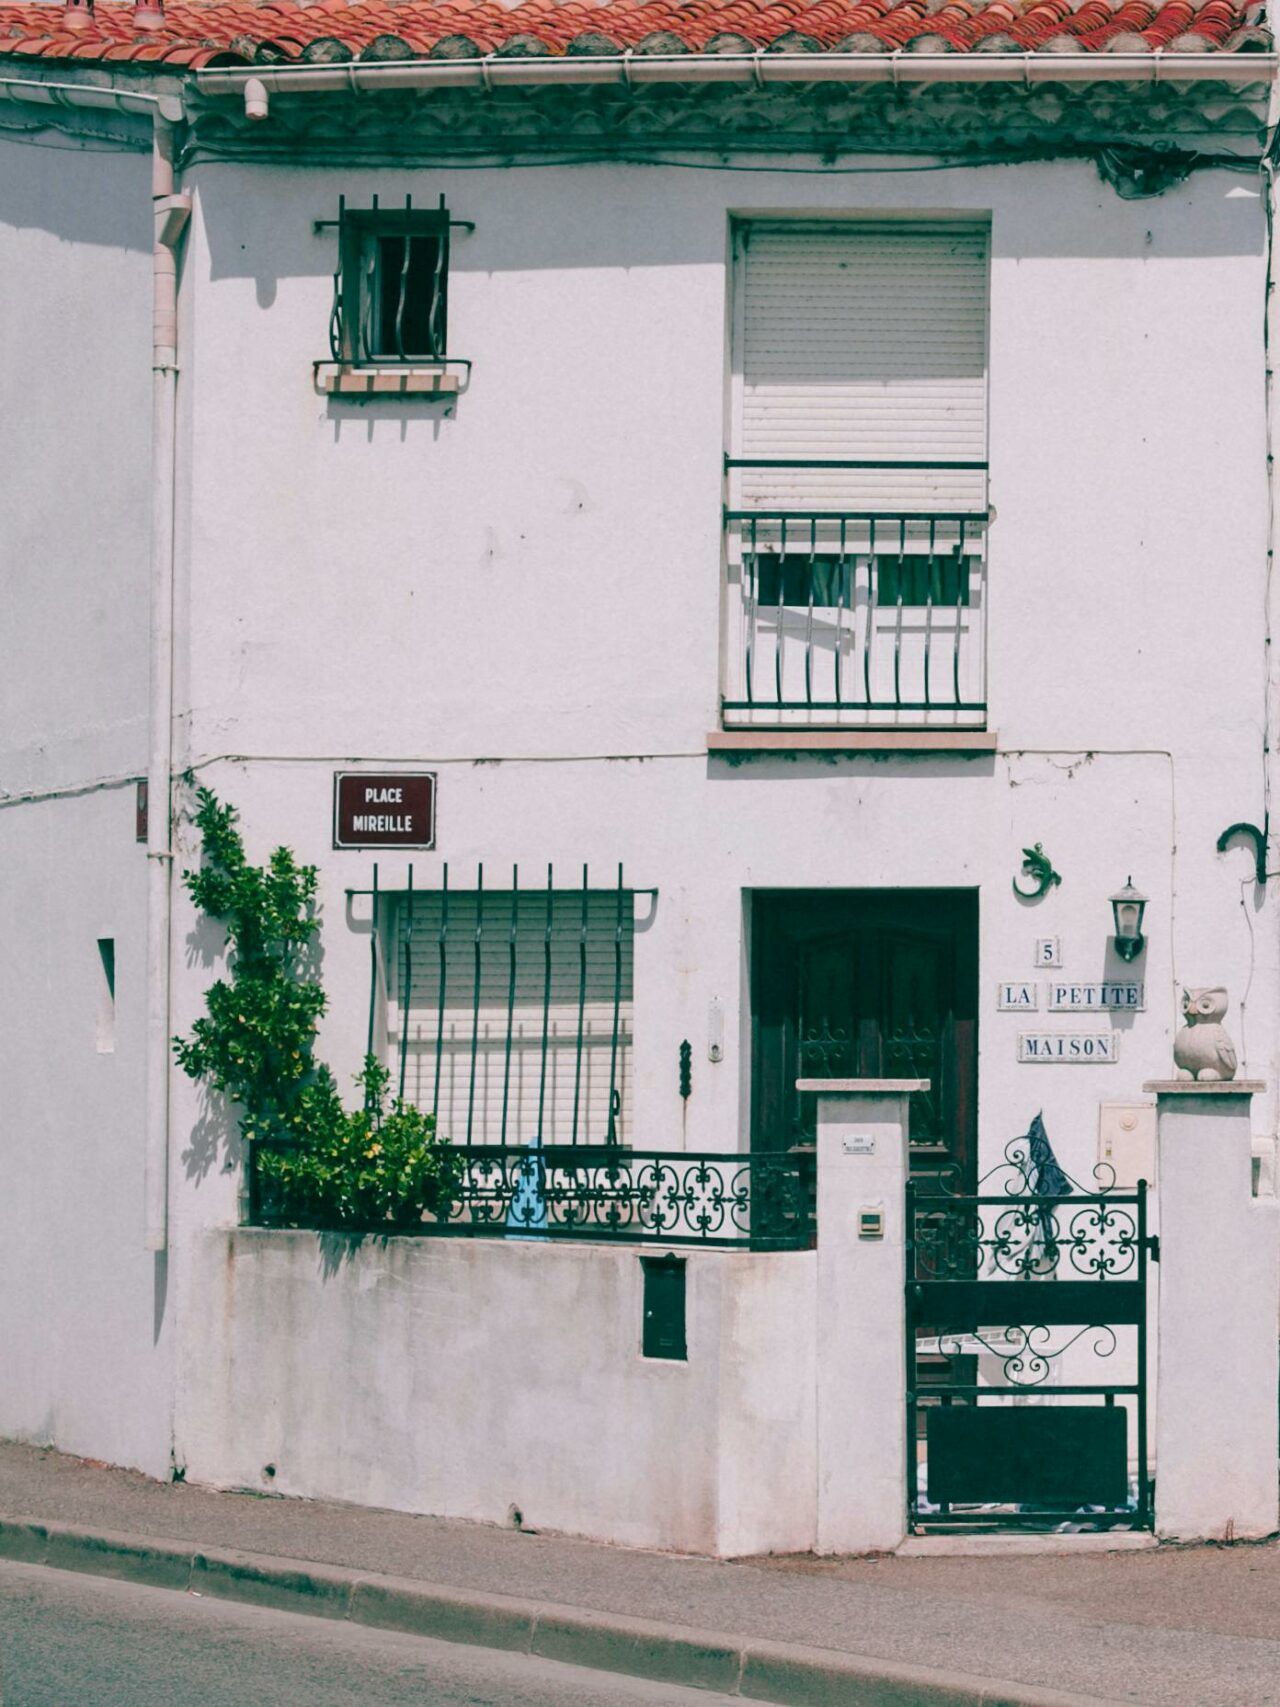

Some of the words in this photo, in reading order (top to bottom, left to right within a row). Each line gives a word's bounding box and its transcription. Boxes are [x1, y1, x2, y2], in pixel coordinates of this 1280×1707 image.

[365, 788, 402, 803] PLACE
[353, 815, 412, 832] MIREILLE
[1043, 944, 1053, 961] 5
[1006, 987, 1030, 1004] LA
[1056, 987, 1138, 1004] PETITE
[1026, 1039, 1109, 1056] MAISON
